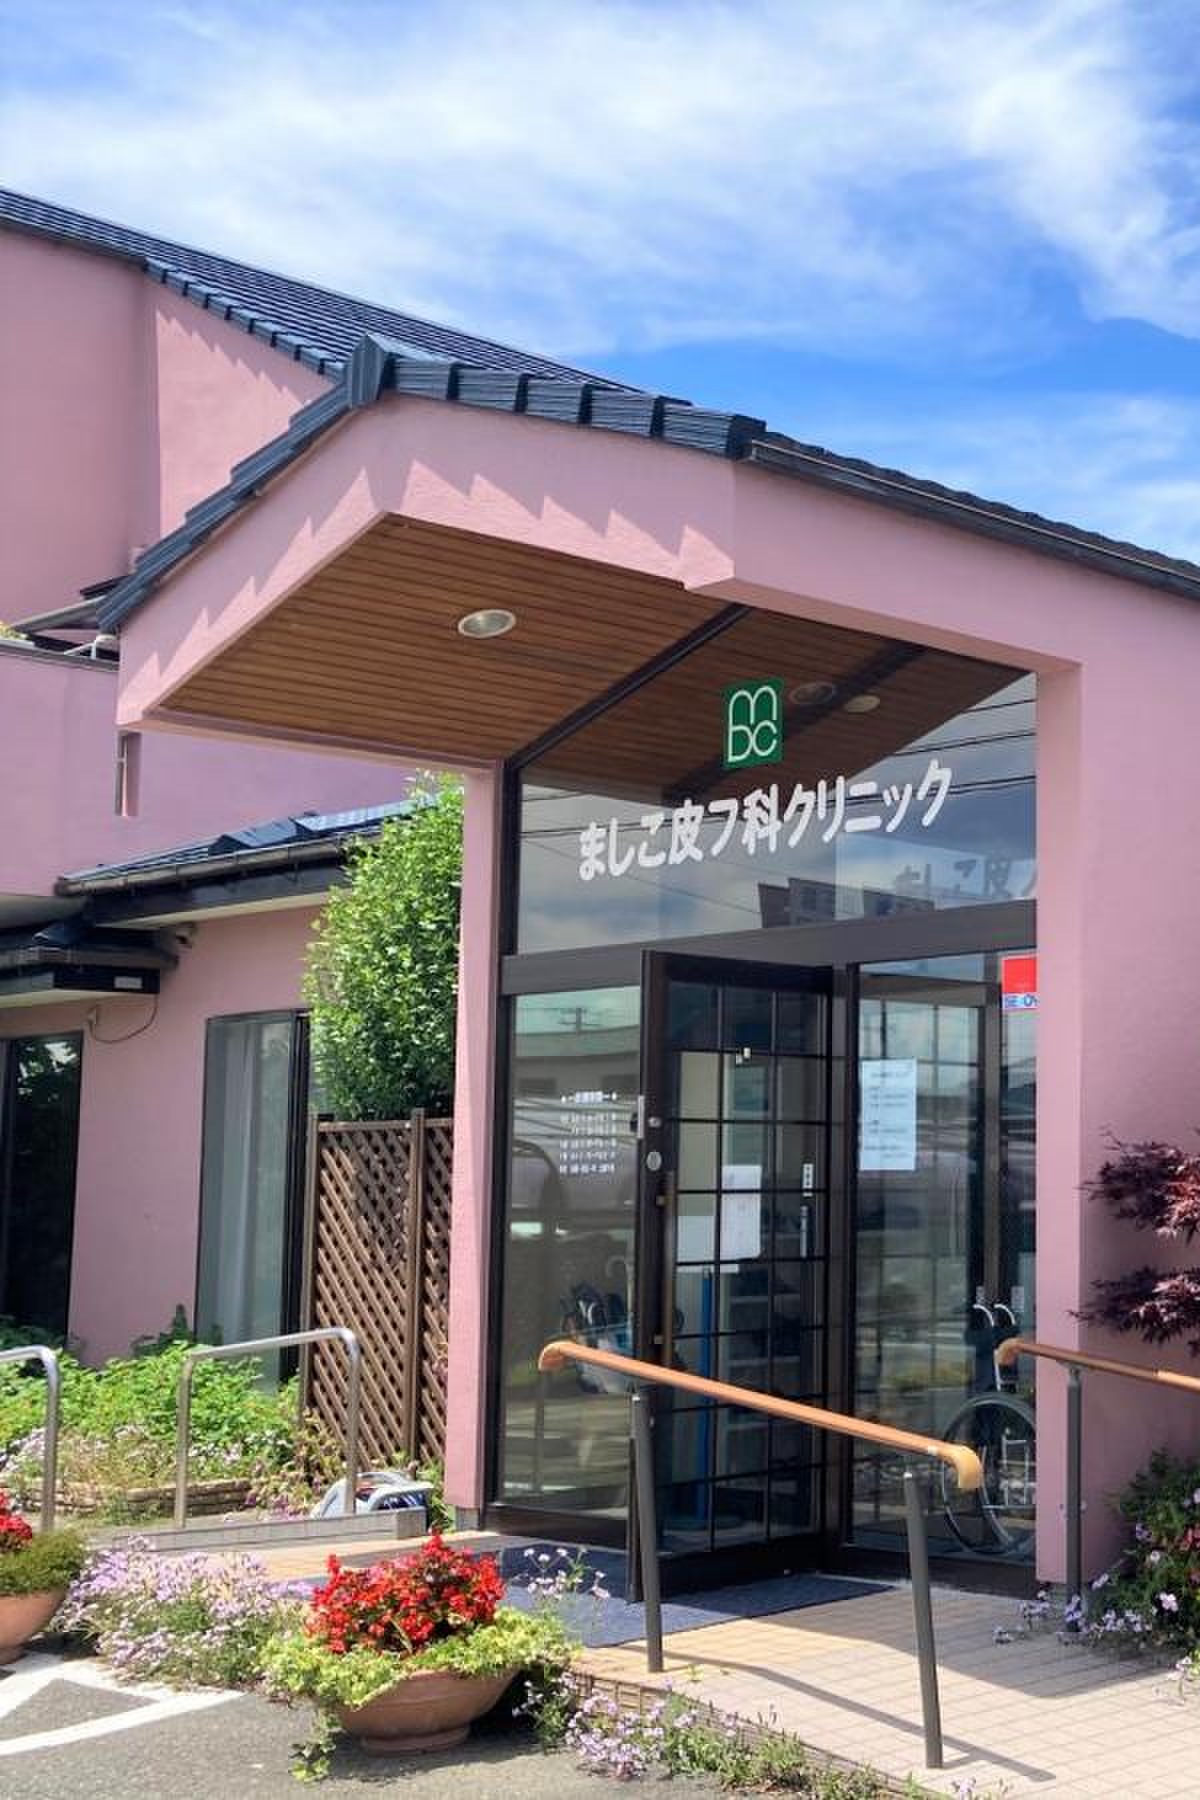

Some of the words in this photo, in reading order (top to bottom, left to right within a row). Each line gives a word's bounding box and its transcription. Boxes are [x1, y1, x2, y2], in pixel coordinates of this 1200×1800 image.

[579, 759, 952, 881] ましこ皮フ科クリニック
